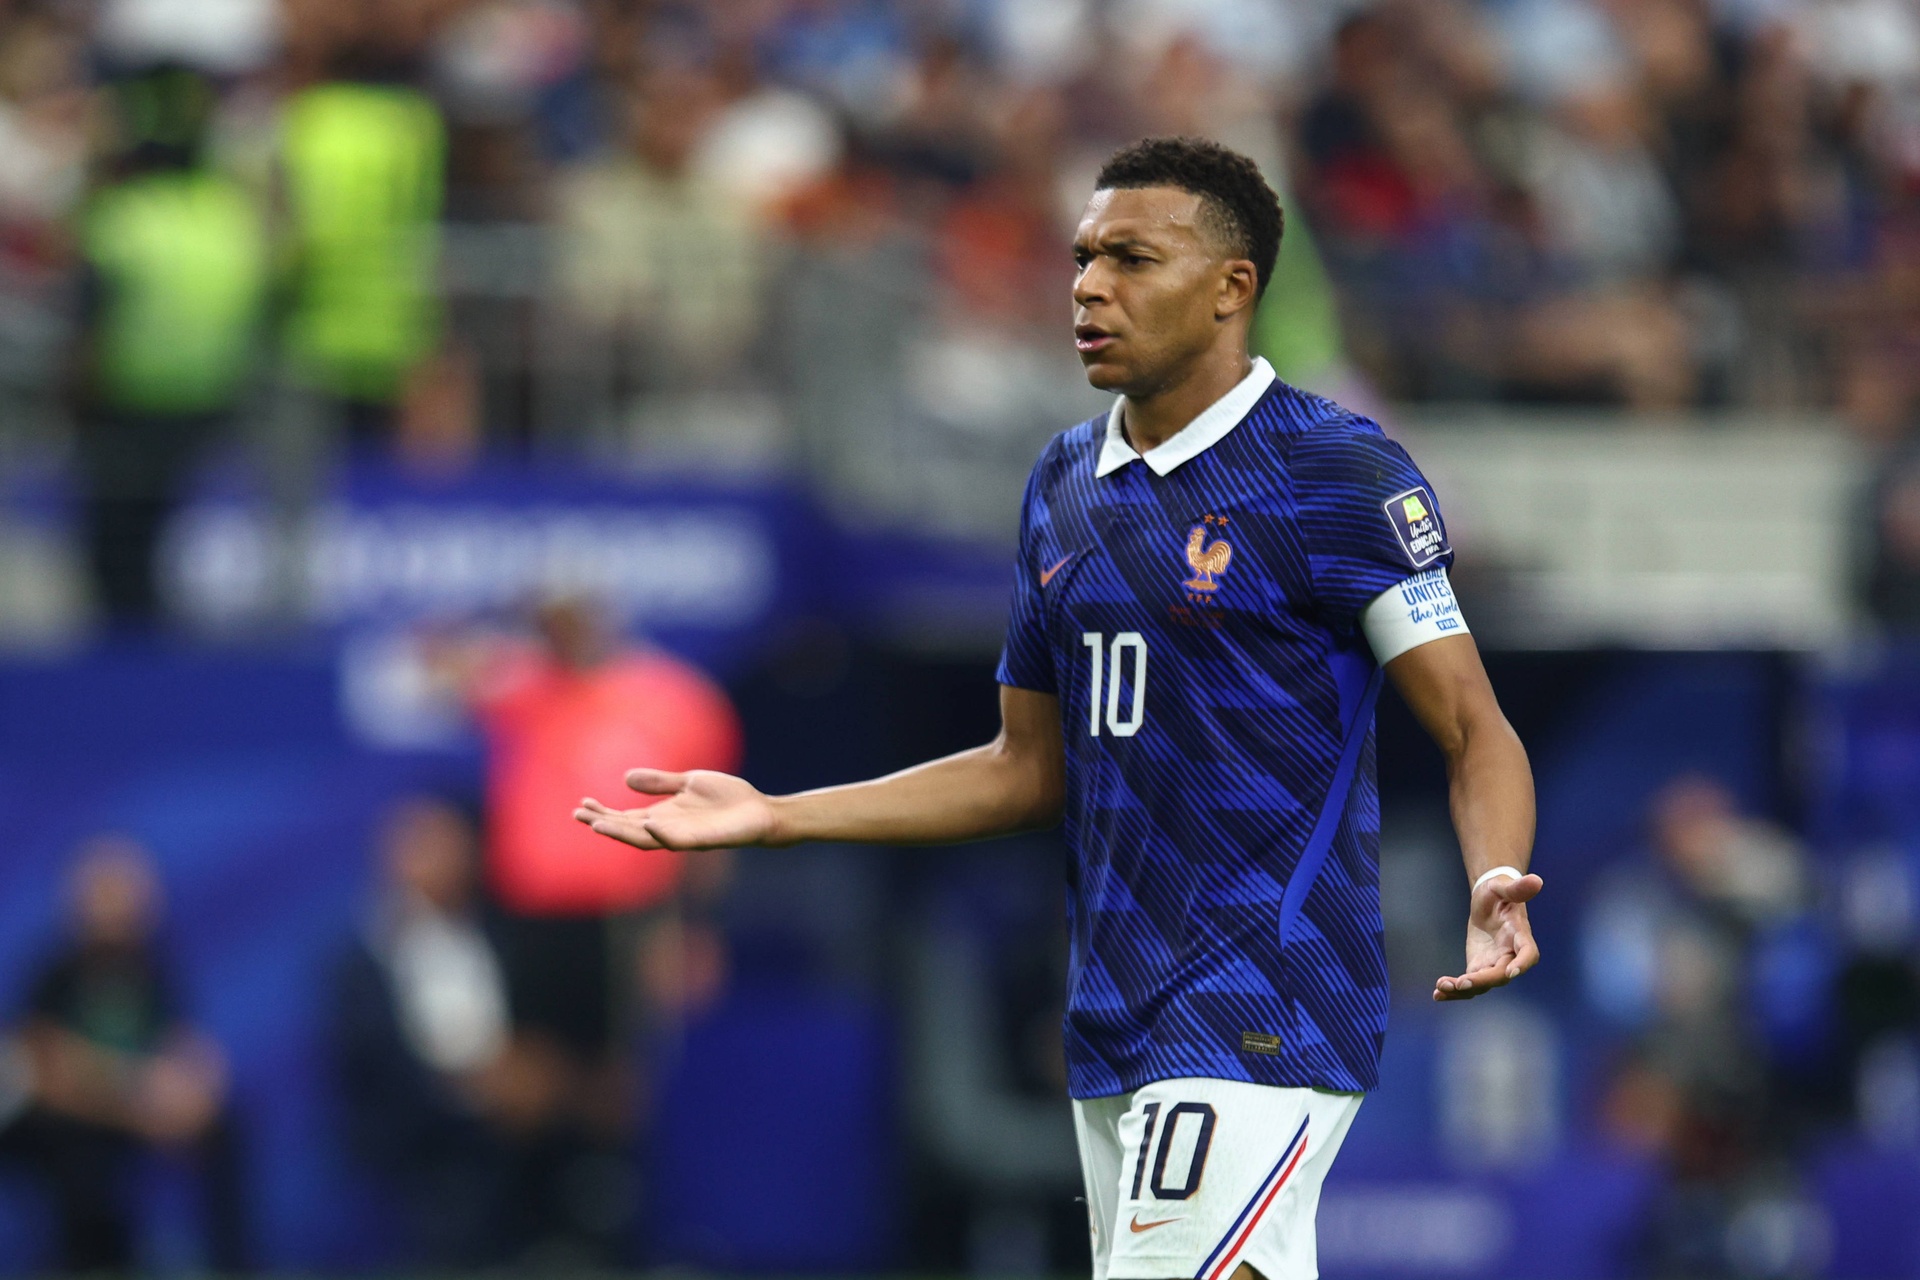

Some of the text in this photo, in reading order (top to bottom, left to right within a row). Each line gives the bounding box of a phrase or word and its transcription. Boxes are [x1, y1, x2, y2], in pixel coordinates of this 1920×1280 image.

[1402, 580, 1452, 606] UNITES
[1408, 607, 1433, 624] the
[1083, 632, 1147, 736] 10
[1131, 1102, 1218, 1200] 10
